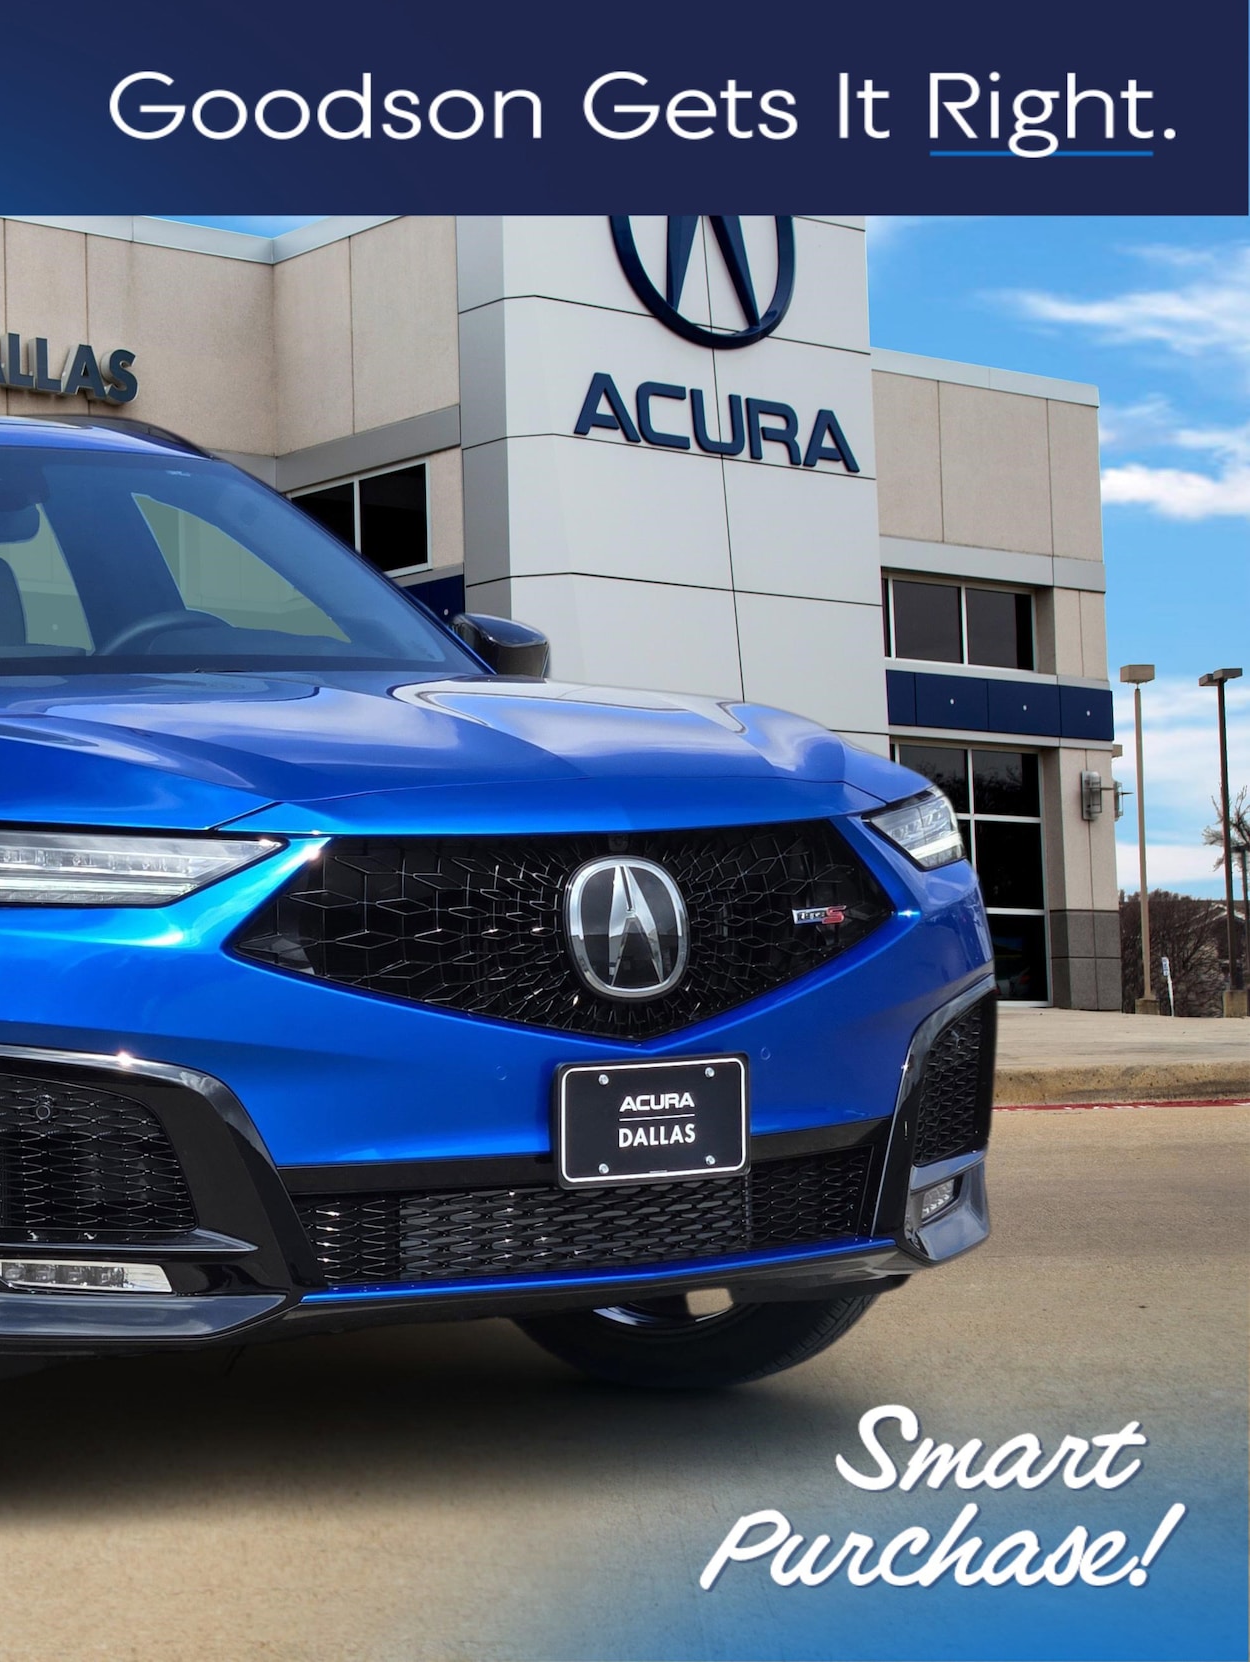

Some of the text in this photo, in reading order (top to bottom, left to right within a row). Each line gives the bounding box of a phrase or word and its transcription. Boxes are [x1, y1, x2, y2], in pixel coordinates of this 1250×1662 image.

[573, 372, 861, 473] ACURA
[619, 1092, 695, 1112] ACURA
[618, 1123, 696, 1148] DALLAS
